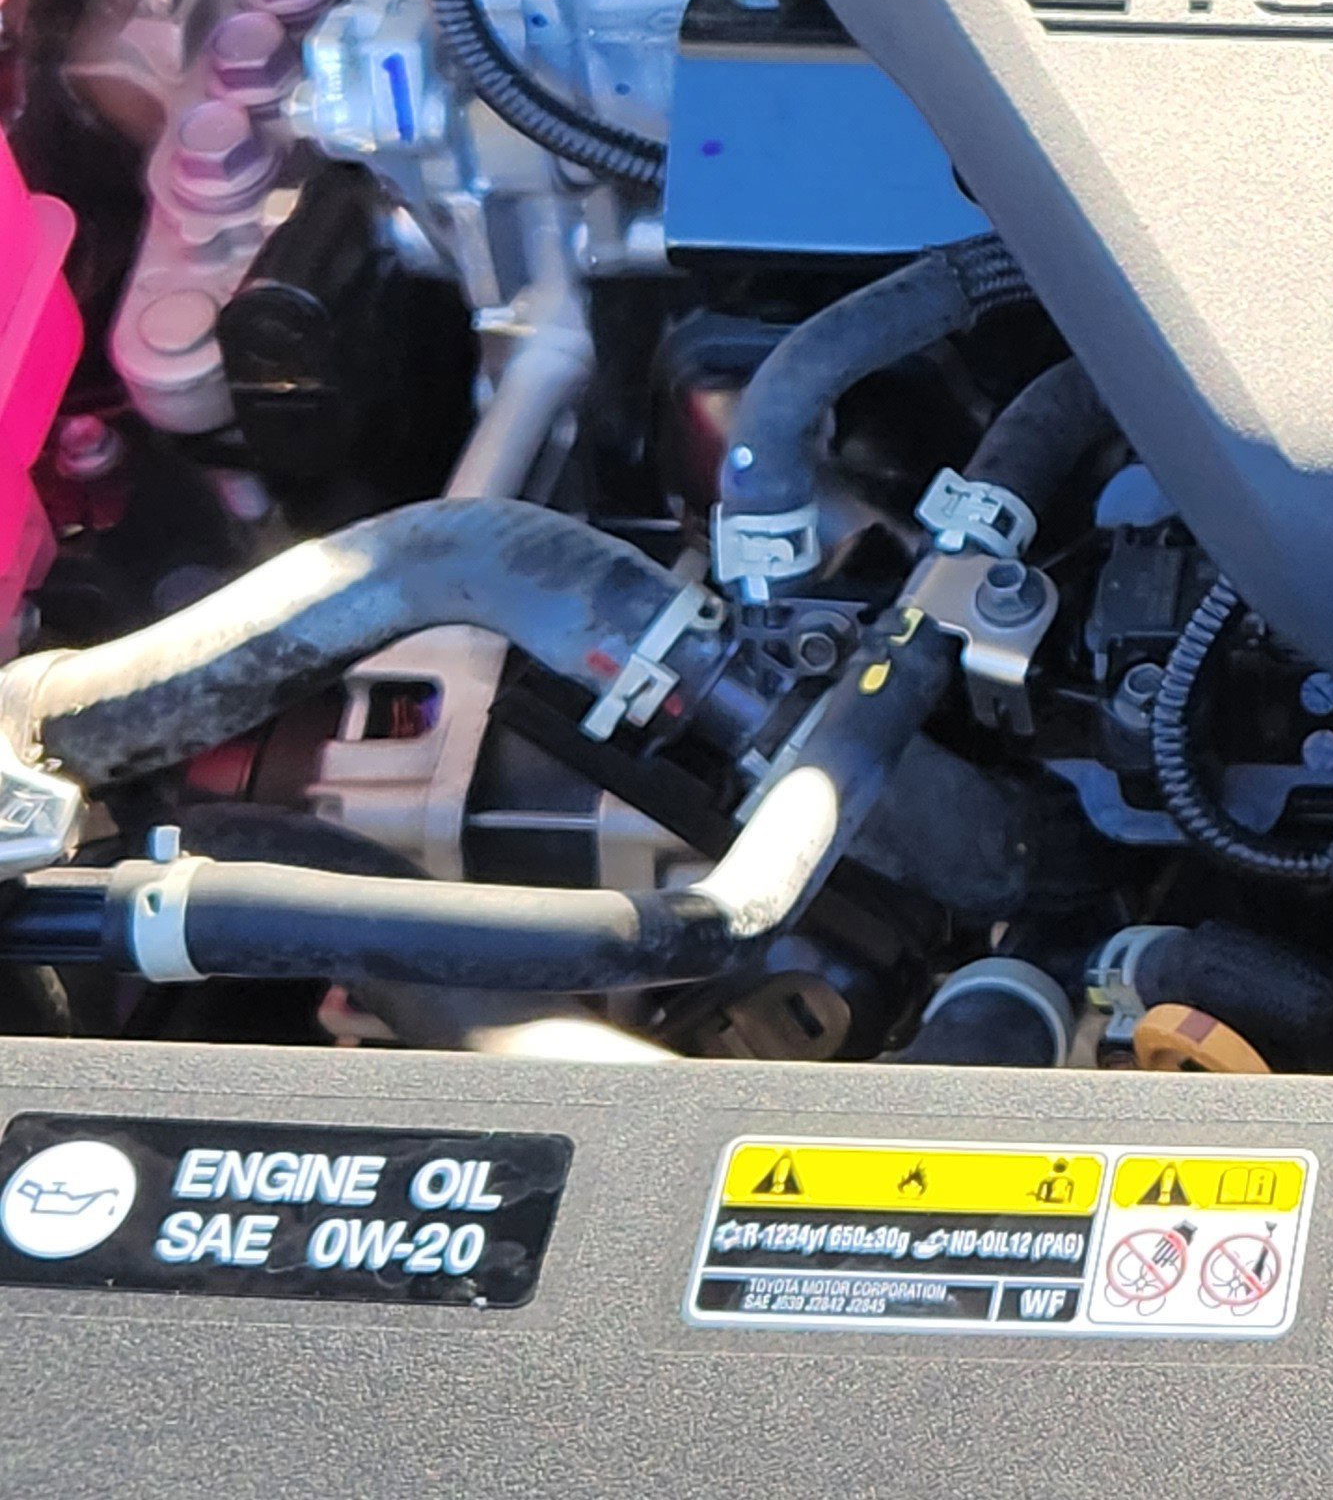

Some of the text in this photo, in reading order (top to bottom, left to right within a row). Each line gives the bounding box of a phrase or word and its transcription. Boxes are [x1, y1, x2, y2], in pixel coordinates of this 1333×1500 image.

[172, 1148, 503, 1212] ENGINE OIL
[154, 1211, 486, 1276] SAE 0W-20
[1030, 1232, 1085, 1264] (PAG)
[744, 1293, 771, 1310] SAE
[749, 1277, 947, 1301] TOYOTA MOTOR CORPORATION
[1019, 1289, 1067, 1319] WF
